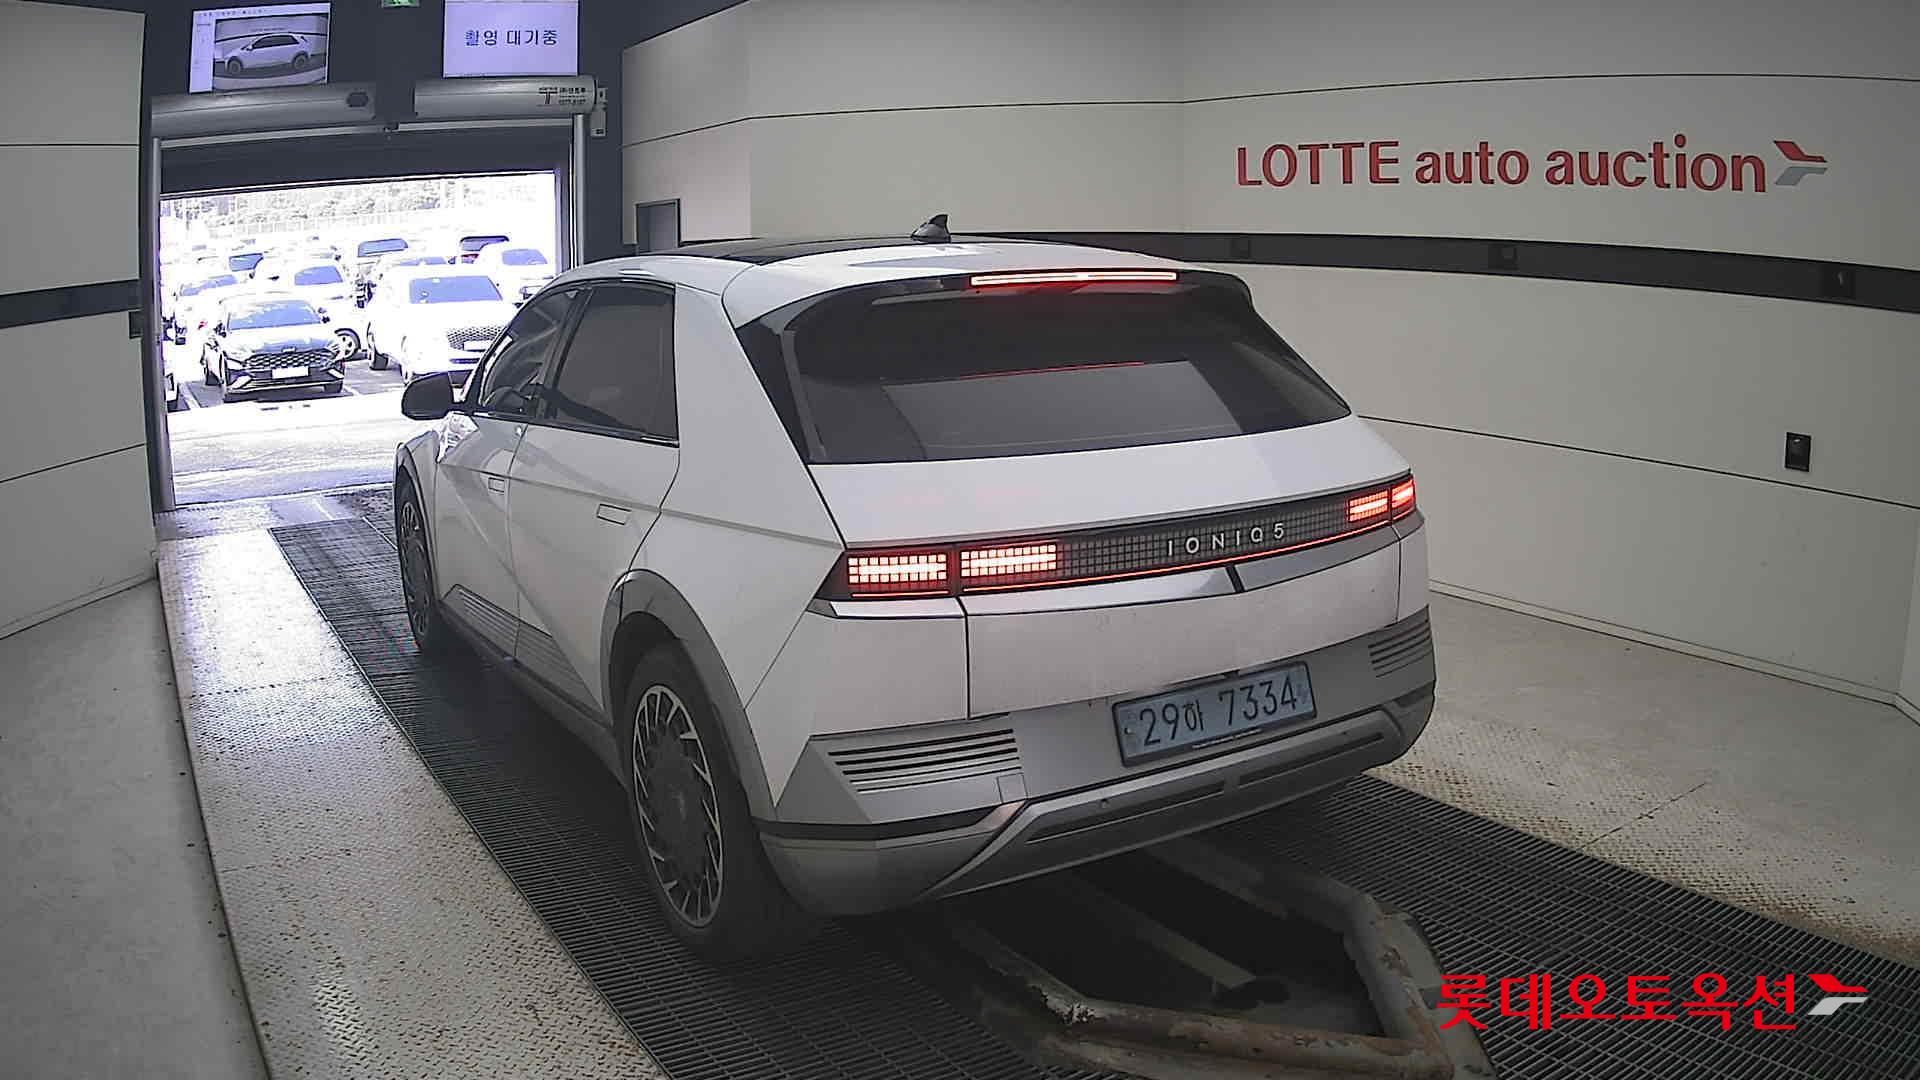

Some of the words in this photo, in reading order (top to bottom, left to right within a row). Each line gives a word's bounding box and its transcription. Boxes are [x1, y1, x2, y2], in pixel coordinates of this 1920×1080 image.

[464, 29, 498, 46] 촬영
[506, 29, 558, 46] 대기중
[1236, 140, 1400, 188] LOTTE
[1414, 140, 1531, 186] auto
[1544, 133, 1767, 193] auction
[1166, 526, 1264, 557] IONIQ
[1273, 522, 1285, 540] 5
[1138, 699, 1205, 747] 29하
[1217, 674, 1298, 727] 7334
